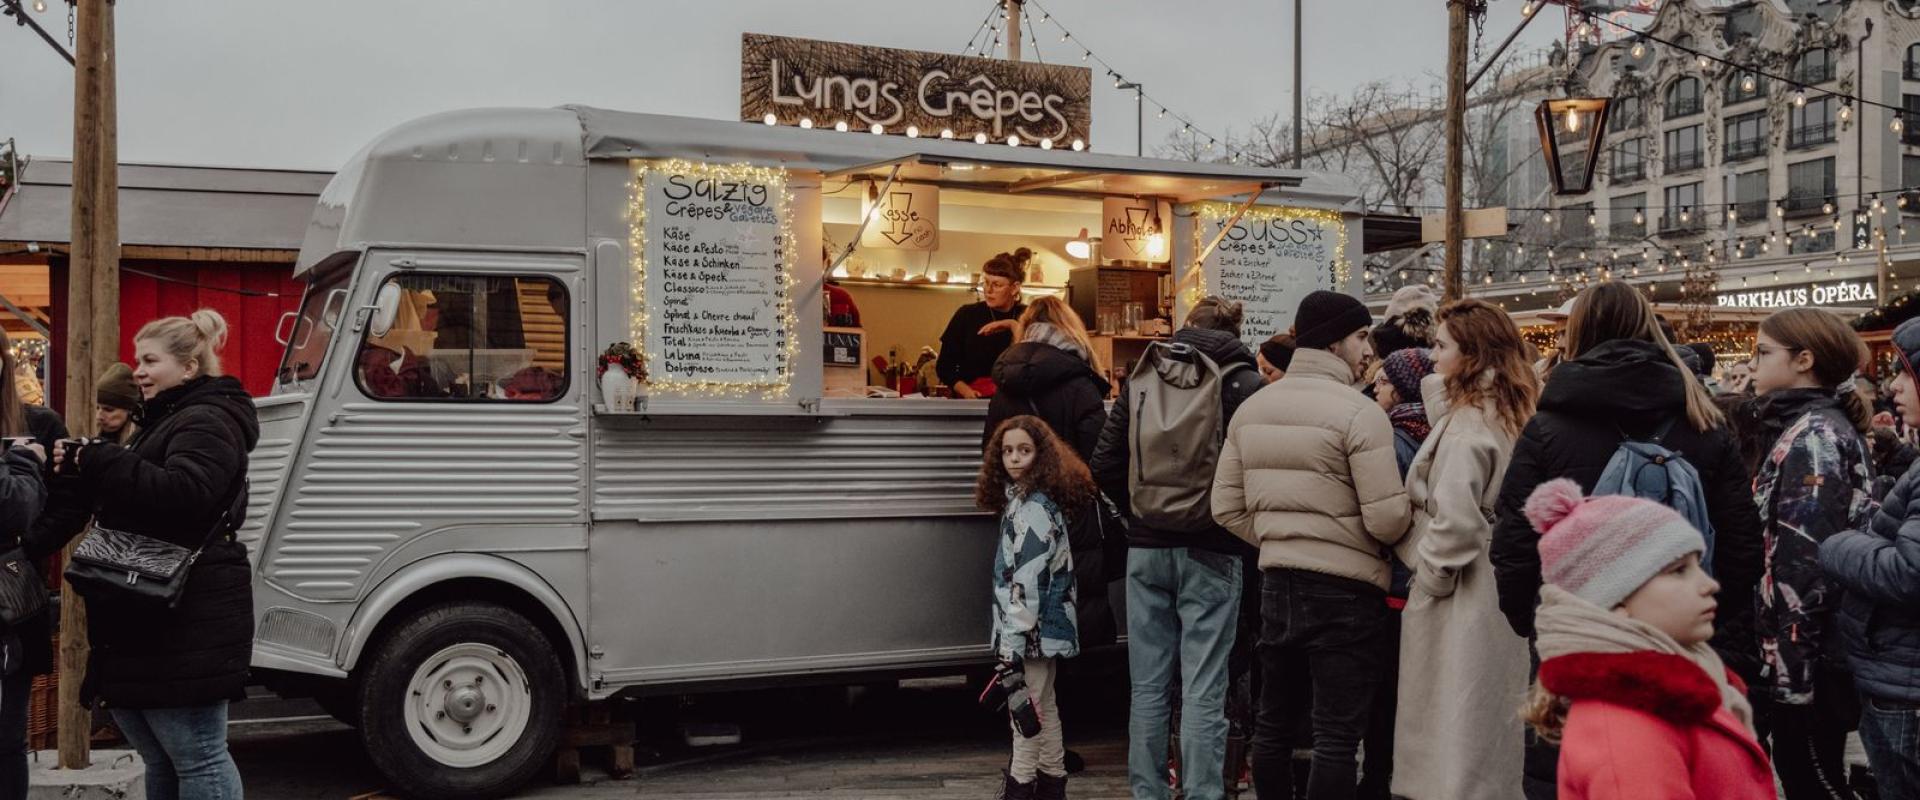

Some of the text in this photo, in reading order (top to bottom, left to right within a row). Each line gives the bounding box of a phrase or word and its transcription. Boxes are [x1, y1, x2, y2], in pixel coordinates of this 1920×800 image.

[771, 58, 1068, 143] Lunas Crêpes
[663, 174, 768, 207] Salzig
[666, 200, 725, 221] Crêpes
[723, 202, 733, 213] &
[663, 225, 691, 242] Käse
[1218, 239, 1266, 255] Crêpes
[1717, 288, 1808, 308] PARKHAUS
[661, 335, 686, 347] Total
